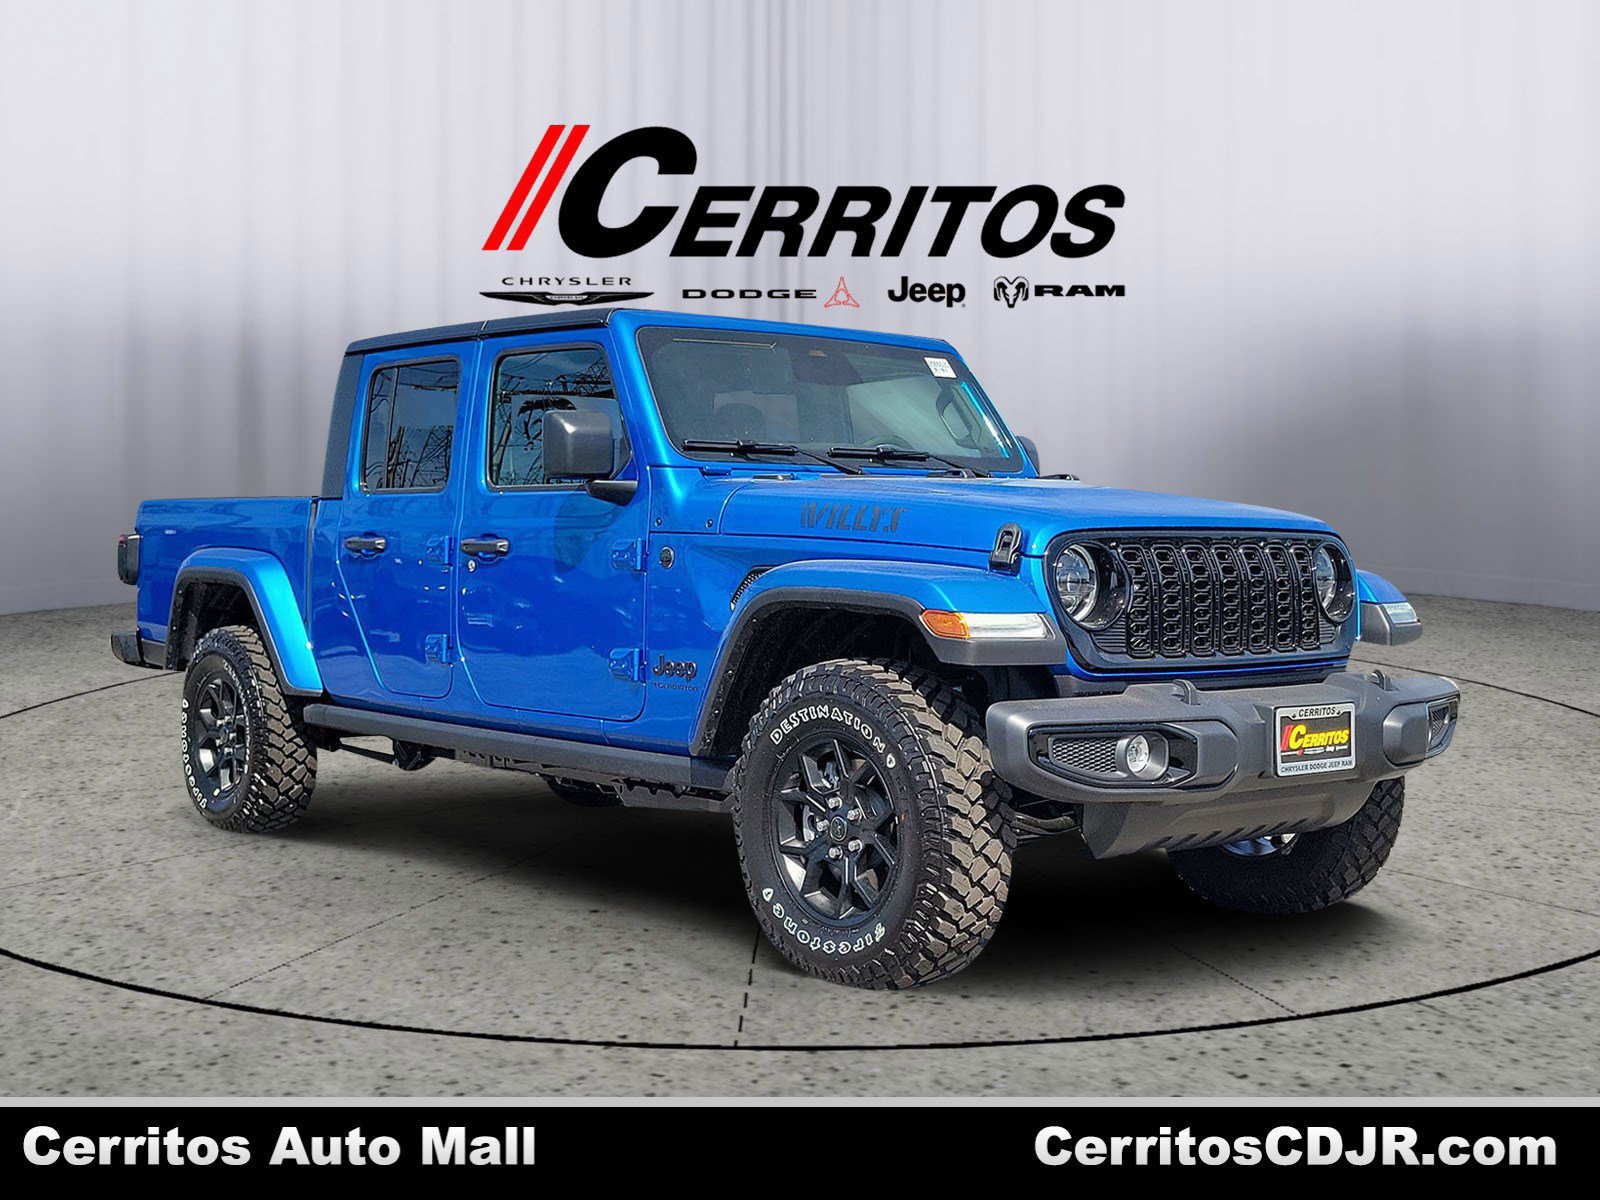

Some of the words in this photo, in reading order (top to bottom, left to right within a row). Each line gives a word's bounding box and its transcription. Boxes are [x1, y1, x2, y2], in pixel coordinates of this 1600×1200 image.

[501, 277, 632, 286] CHRYSLER
[682, 288, 817, 299] DODGE
[887, 275, 966, 308] Jeep
[1034, 284, 1126, 297] RAM
[800, 502, 909, 533] WILLYS
[653, 653, 698, 682] Jeep
[1298, 706, 1336, 718] CERRITOS
[769, 703, 886, 754] DESTINATION
[1281, 764, 1308, 773] CHRYSLER
[1309, 762, 1327, 770] DODGE
[1341, 759, 1353, 767] RAM
